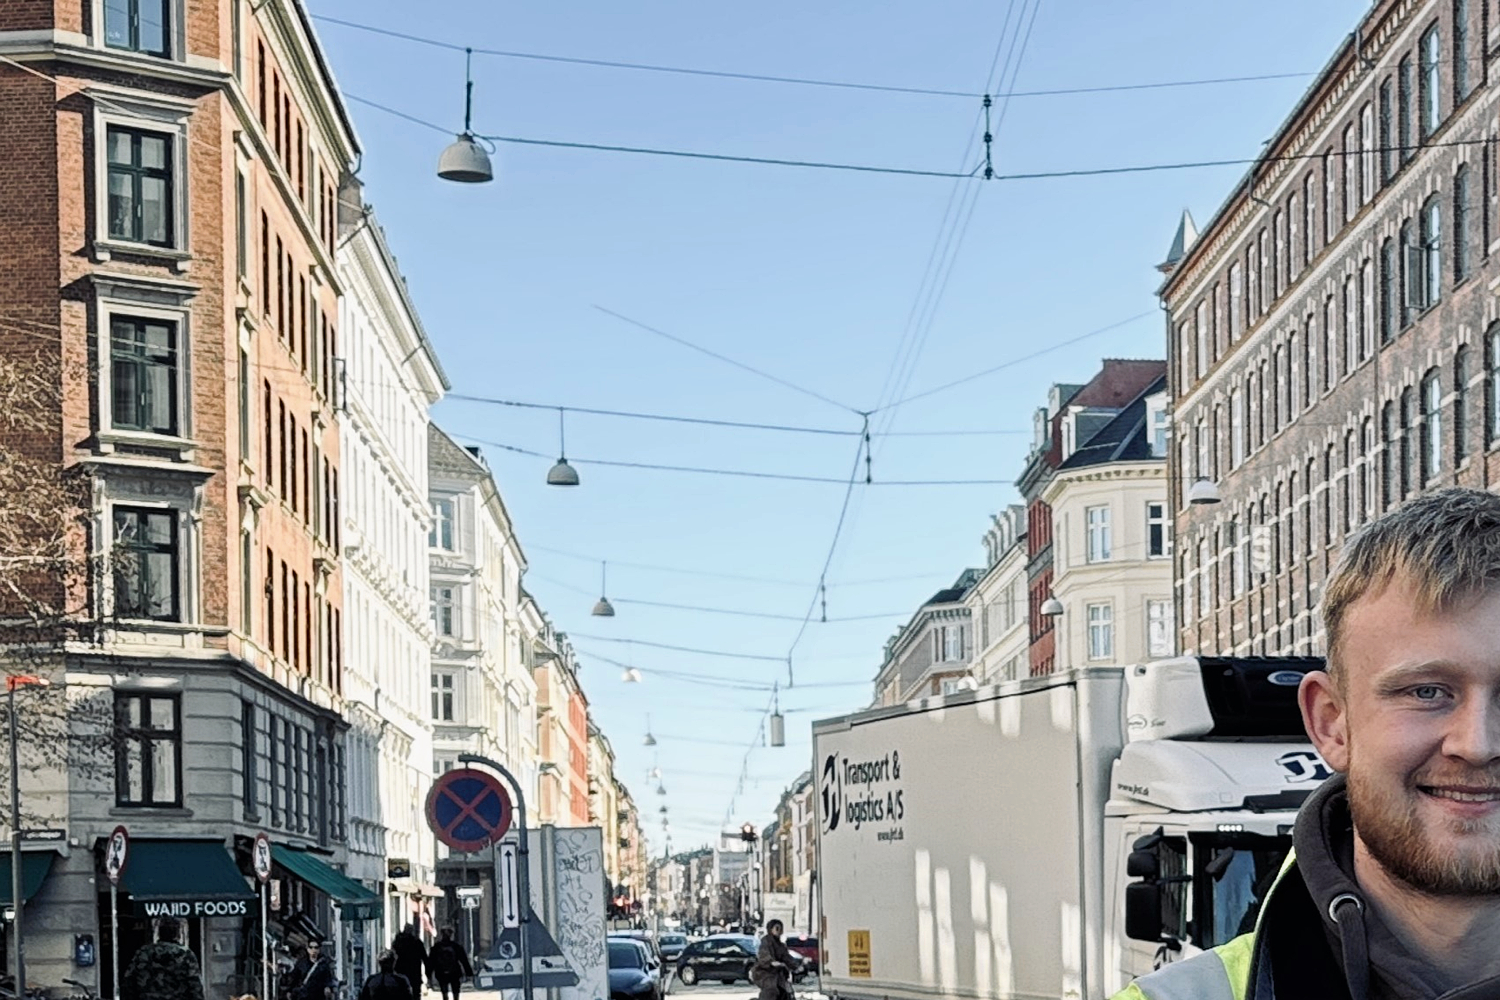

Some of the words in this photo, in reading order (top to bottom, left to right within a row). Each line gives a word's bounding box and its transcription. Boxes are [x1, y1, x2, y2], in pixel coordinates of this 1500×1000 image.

[842, 752, 890, 791] Transport
[892, 750, 901, 780] &
[844, 791, 884, 830] logistics
[887, 789, 904, 823] A/S
[145, 902, 190, 916] WAJID
[195, 901, 247, 915] FOODS
